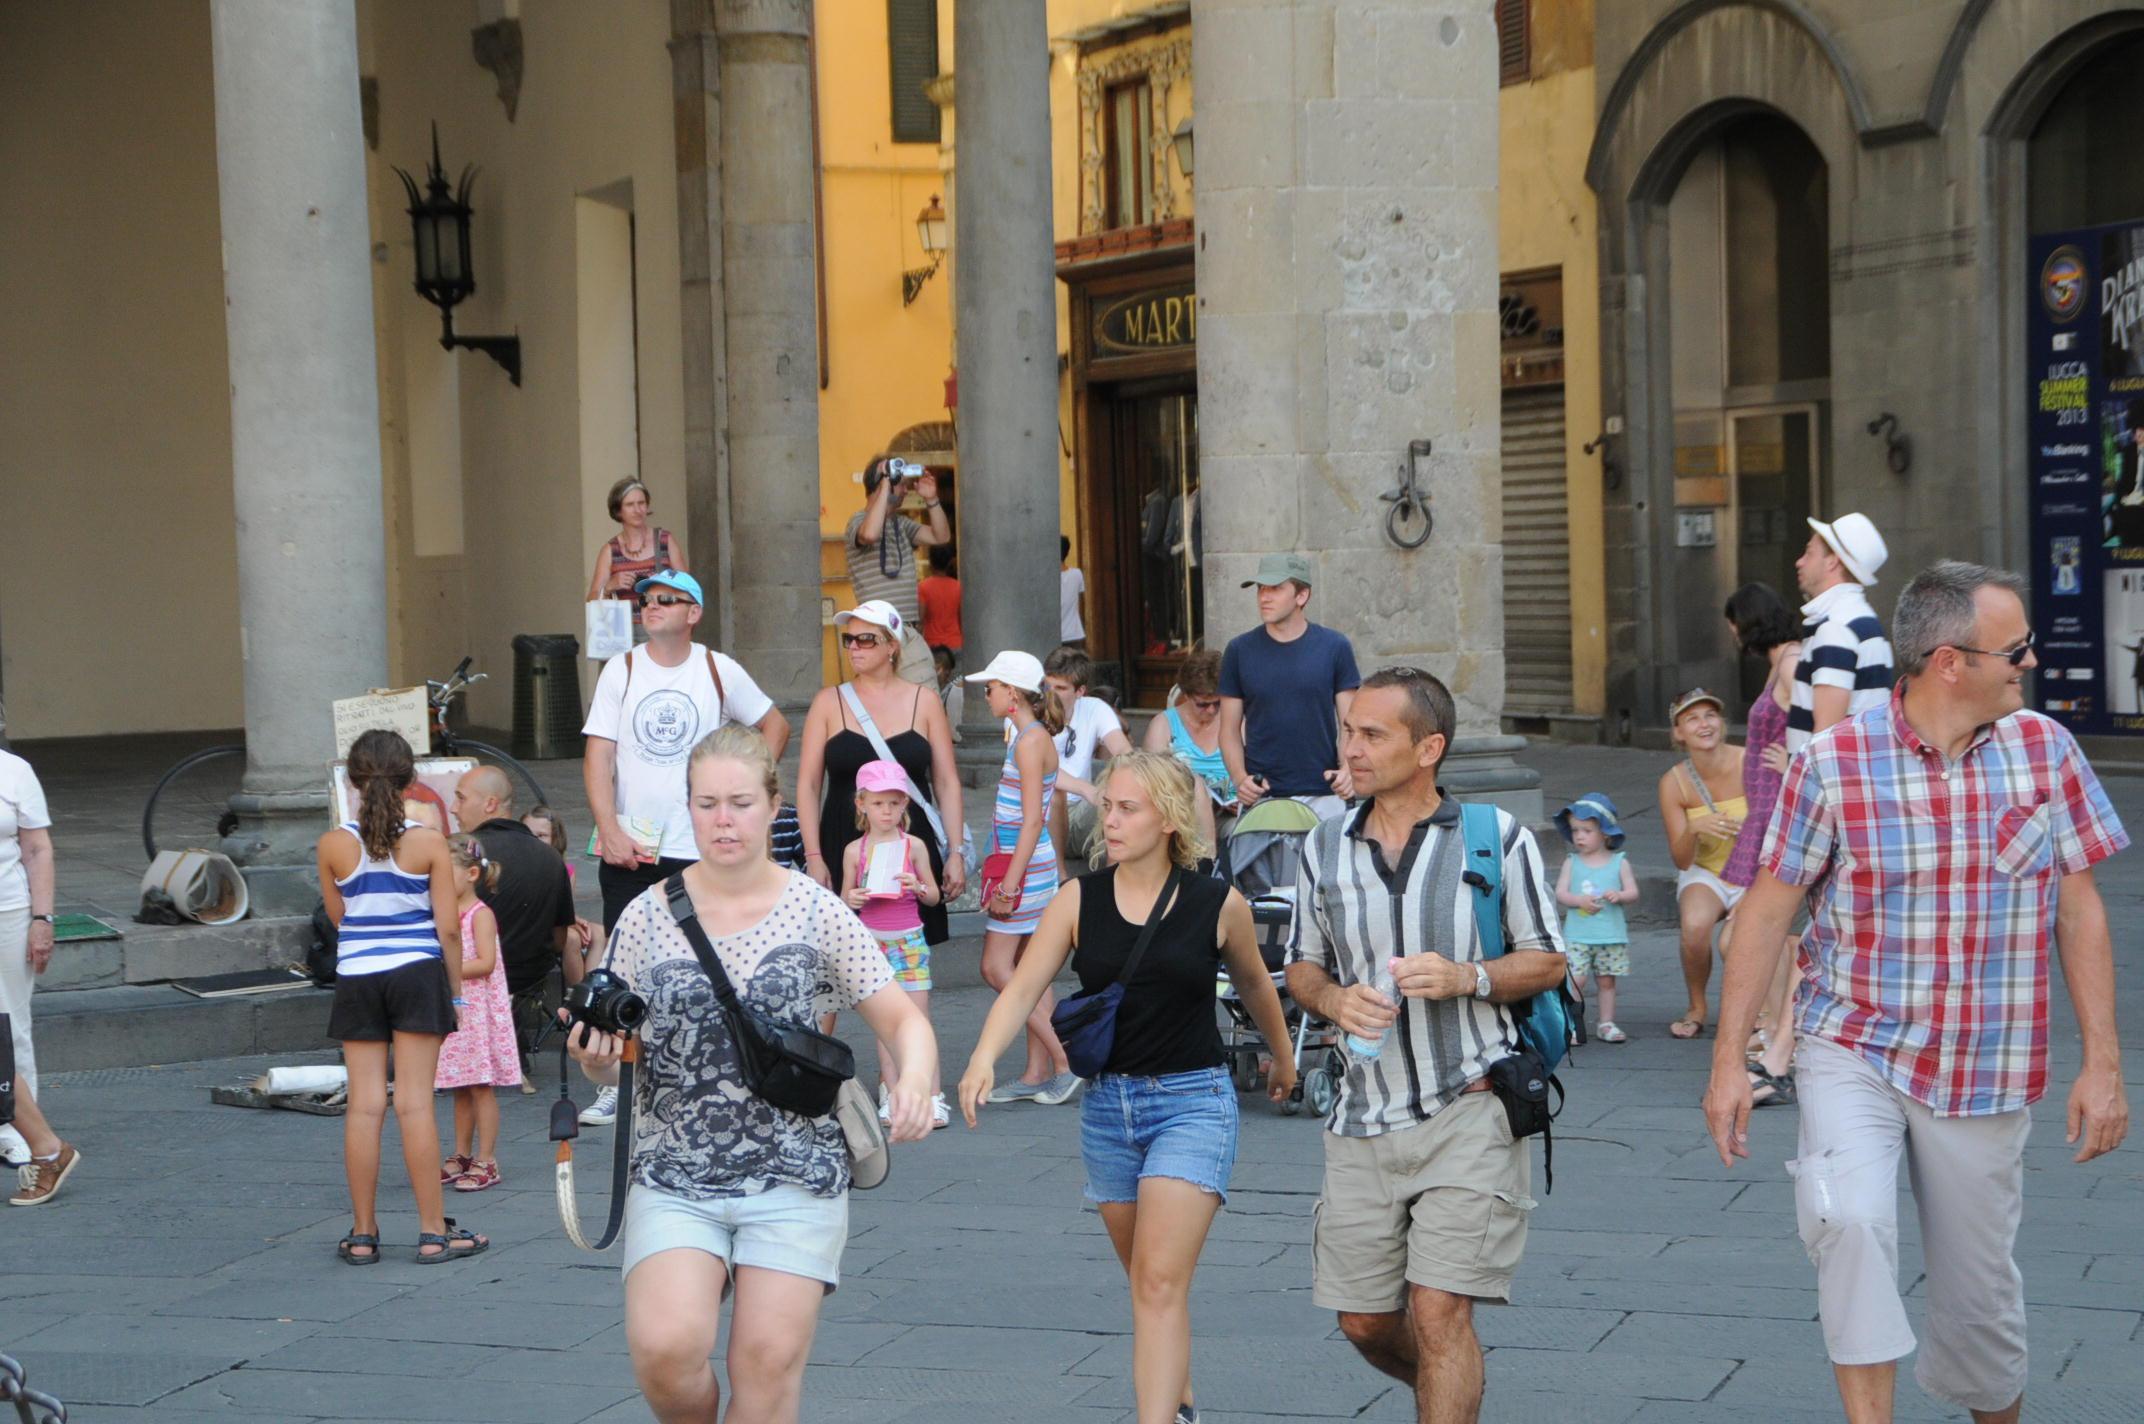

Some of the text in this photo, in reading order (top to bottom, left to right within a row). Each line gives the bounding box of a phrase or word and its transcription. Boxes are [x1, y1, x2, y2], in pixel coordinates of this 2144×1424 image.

[1125, 294, 1196, 343] MART
[2048, 361, 2088, 380] LUCCA
[2040, 376, 2088, 394] SUMMER
[2040, 393, 2088, 412] FESTIVAL
[2056, 409, 2088, 426] 2013
